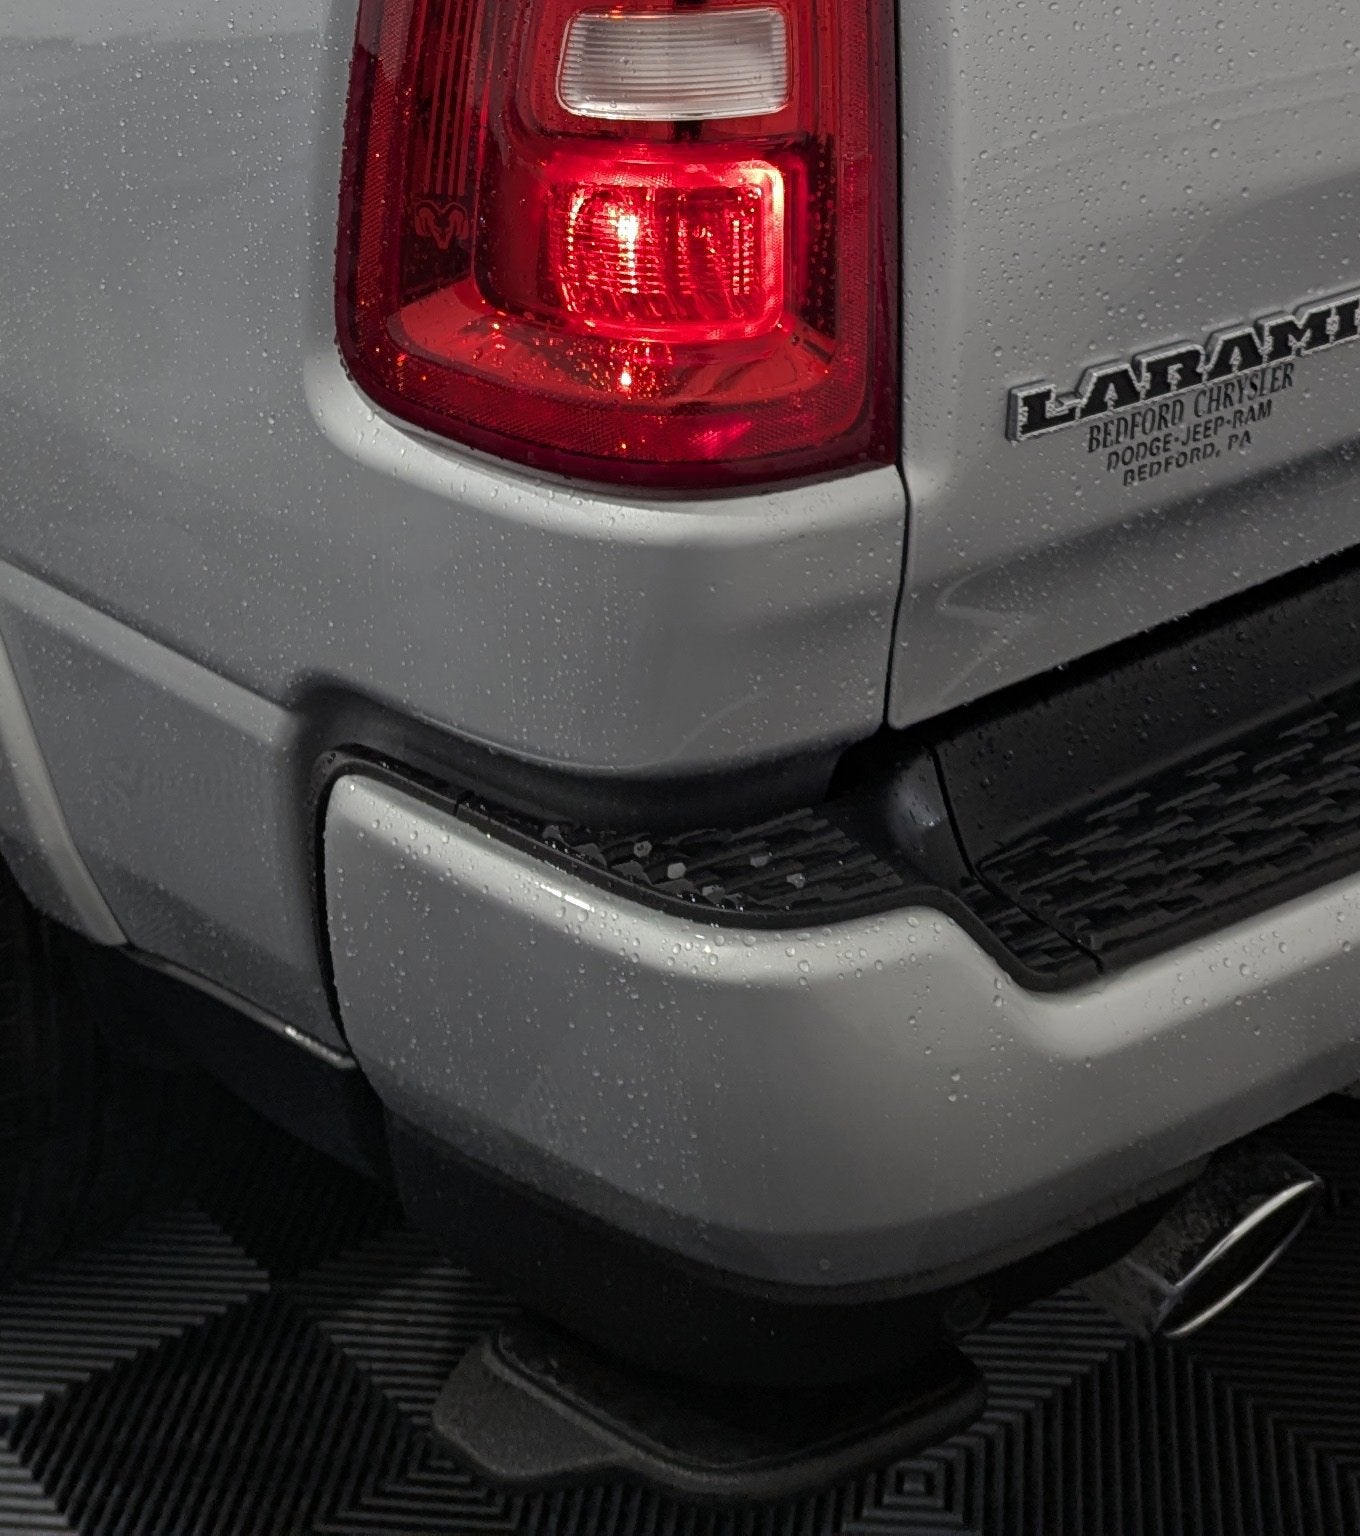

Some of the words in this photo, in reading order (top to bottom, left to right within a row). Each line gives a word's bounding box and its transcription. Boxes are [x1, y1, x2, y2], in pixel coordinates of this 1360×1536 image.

[1088, 398, 1185, 453] BEDFORD
[1194, 363, 1294, 417] CHRYSLER
[1123, 441, 1221, 486] BEDFORD,
[1228, 429, 1252, 450] PA
